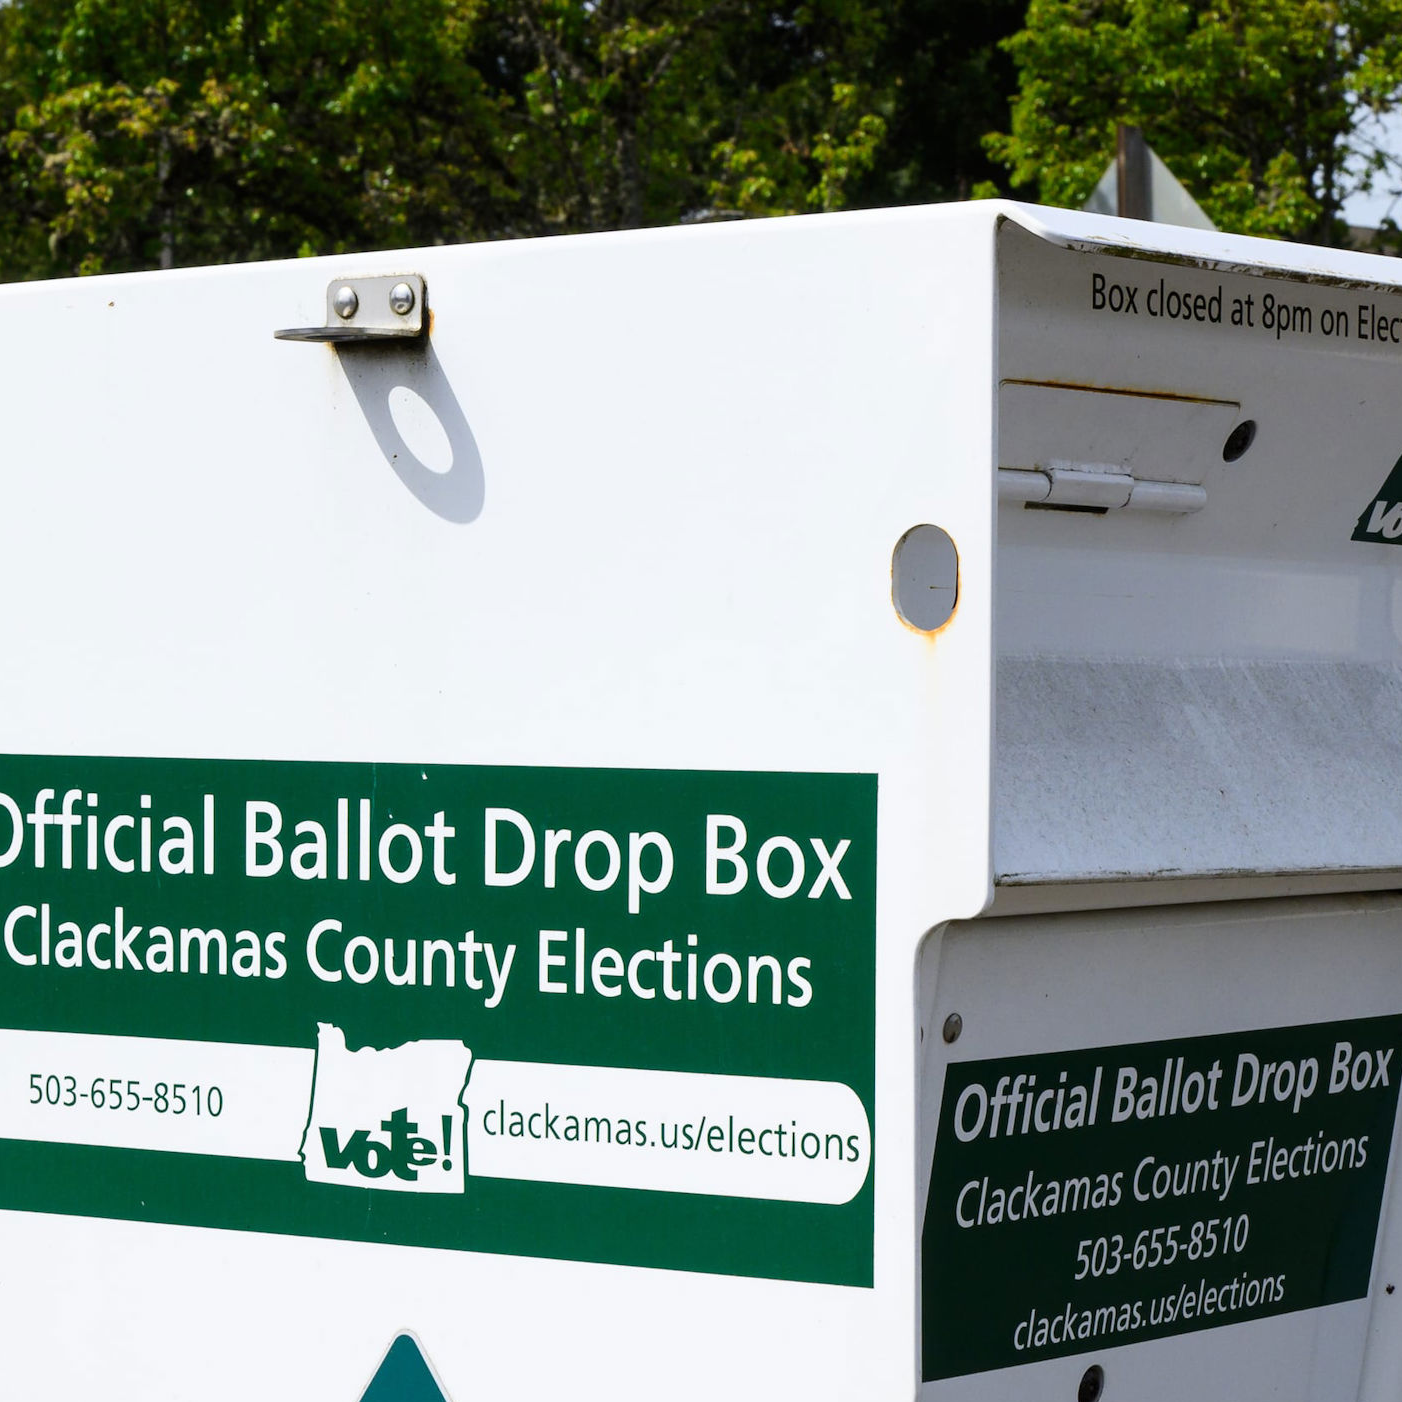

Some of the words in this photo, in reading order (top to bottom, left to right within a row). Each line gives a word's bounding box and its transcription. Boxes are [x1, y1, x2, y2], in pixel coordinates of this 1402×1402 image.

[1093, 273, 1138, 314] Box
[1147, 279, 1221, 323] closed
[1231, 295, 1254, 327] at
[1262, 294, 1311, 339] 8pm
[1321, 310, 1348, 337] on
[246, 798, 456, 885] Ballot
[485, 808, 673, 913] Drop
[706, 815, 852, 899] Box
[4, 904, 287, 978] Clackamas
[307, 919, 516, 1008] County
[539, 928, 812, 1007] Elections
[28, 1072, 224, 1118] 503-655-8510
[482, 1100, 861, 1163] clackamas.us/elections
[955, 1067, 1102, 1142] Official
[1112, 1057, 1222, 1122] Ballot
[1231, 1053, 1318, 1113] Drop
[1329, 1042, 1394, 1093] Box
[956, 1171, 1123, 1228] Clackamas
[1134, 1150, 1239, 1201] County
[1247, 1131, 1368, 1184] Elections
[1074, 1214, 1249, 1280] 503-655-8510
[1013, 1271, 1285, 1350] clackamas.us/elections
